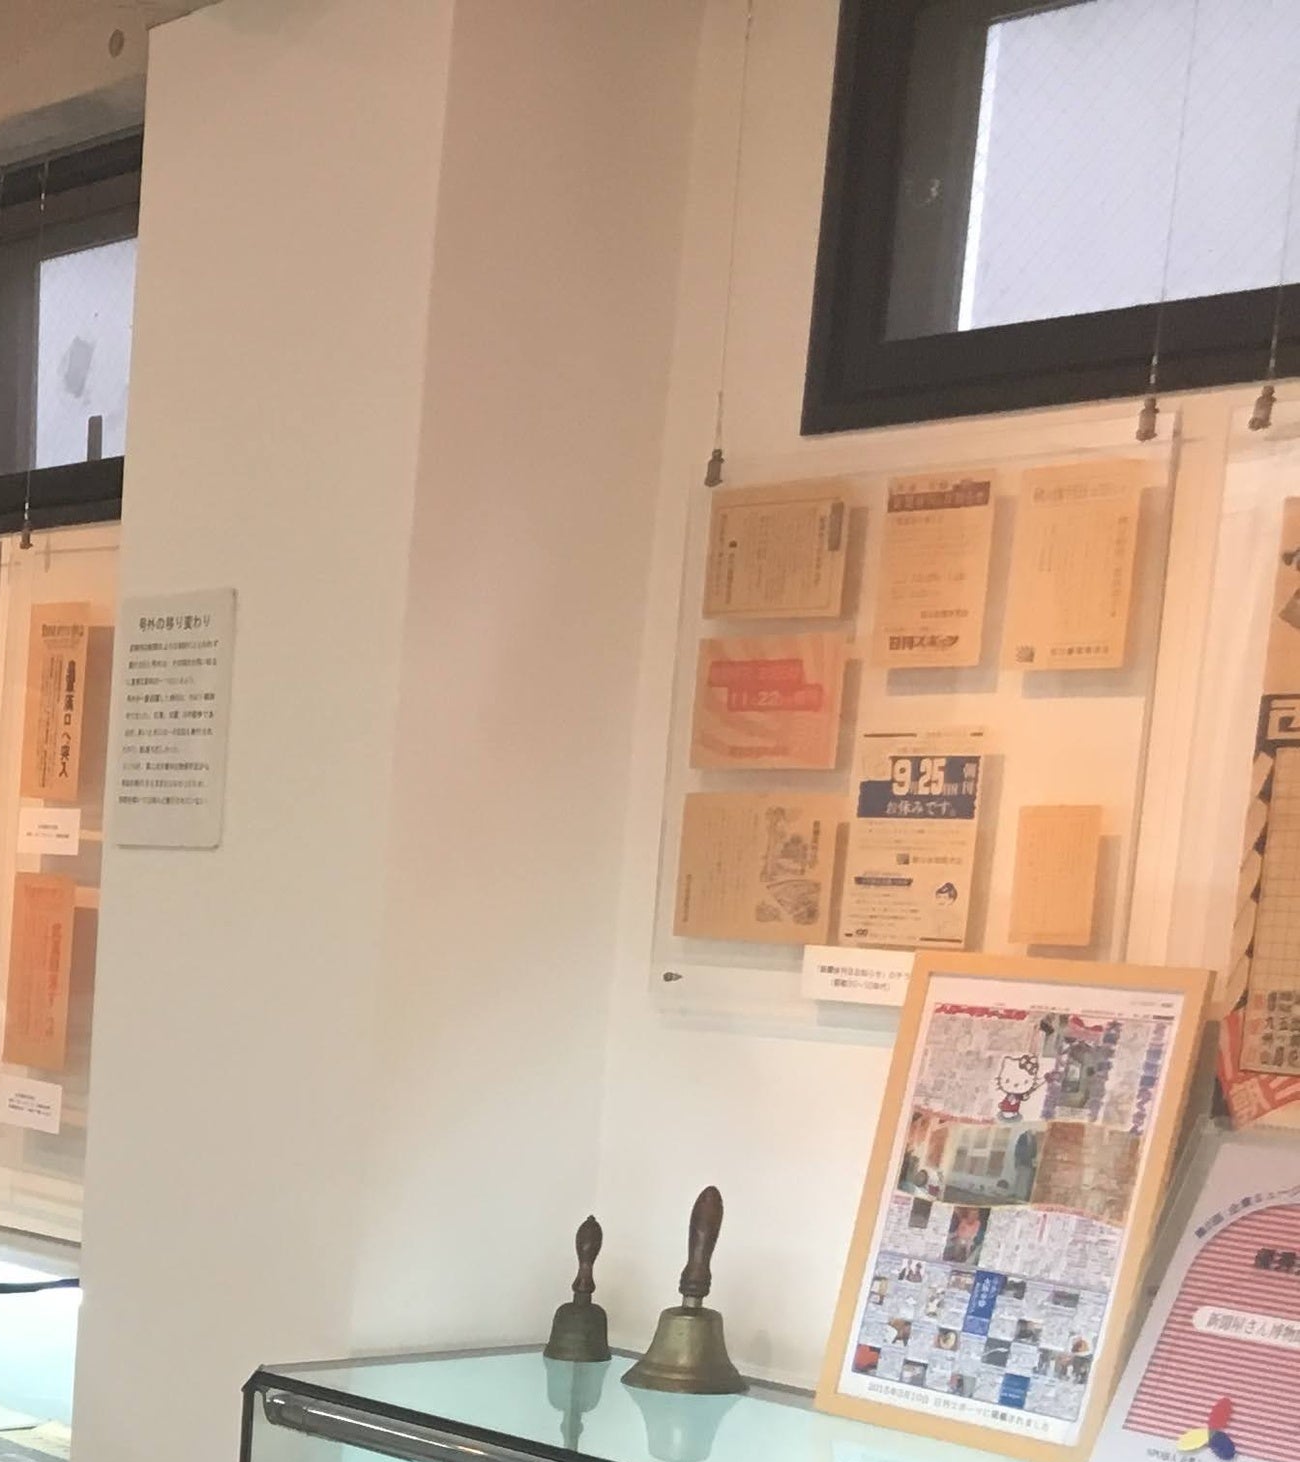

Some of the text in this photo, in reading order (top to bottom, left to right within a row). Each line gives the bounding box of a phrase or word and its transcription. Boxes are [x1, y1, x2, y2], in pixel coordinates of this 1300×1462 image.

[139, 615, 212, 632] 号外の移り変わり
